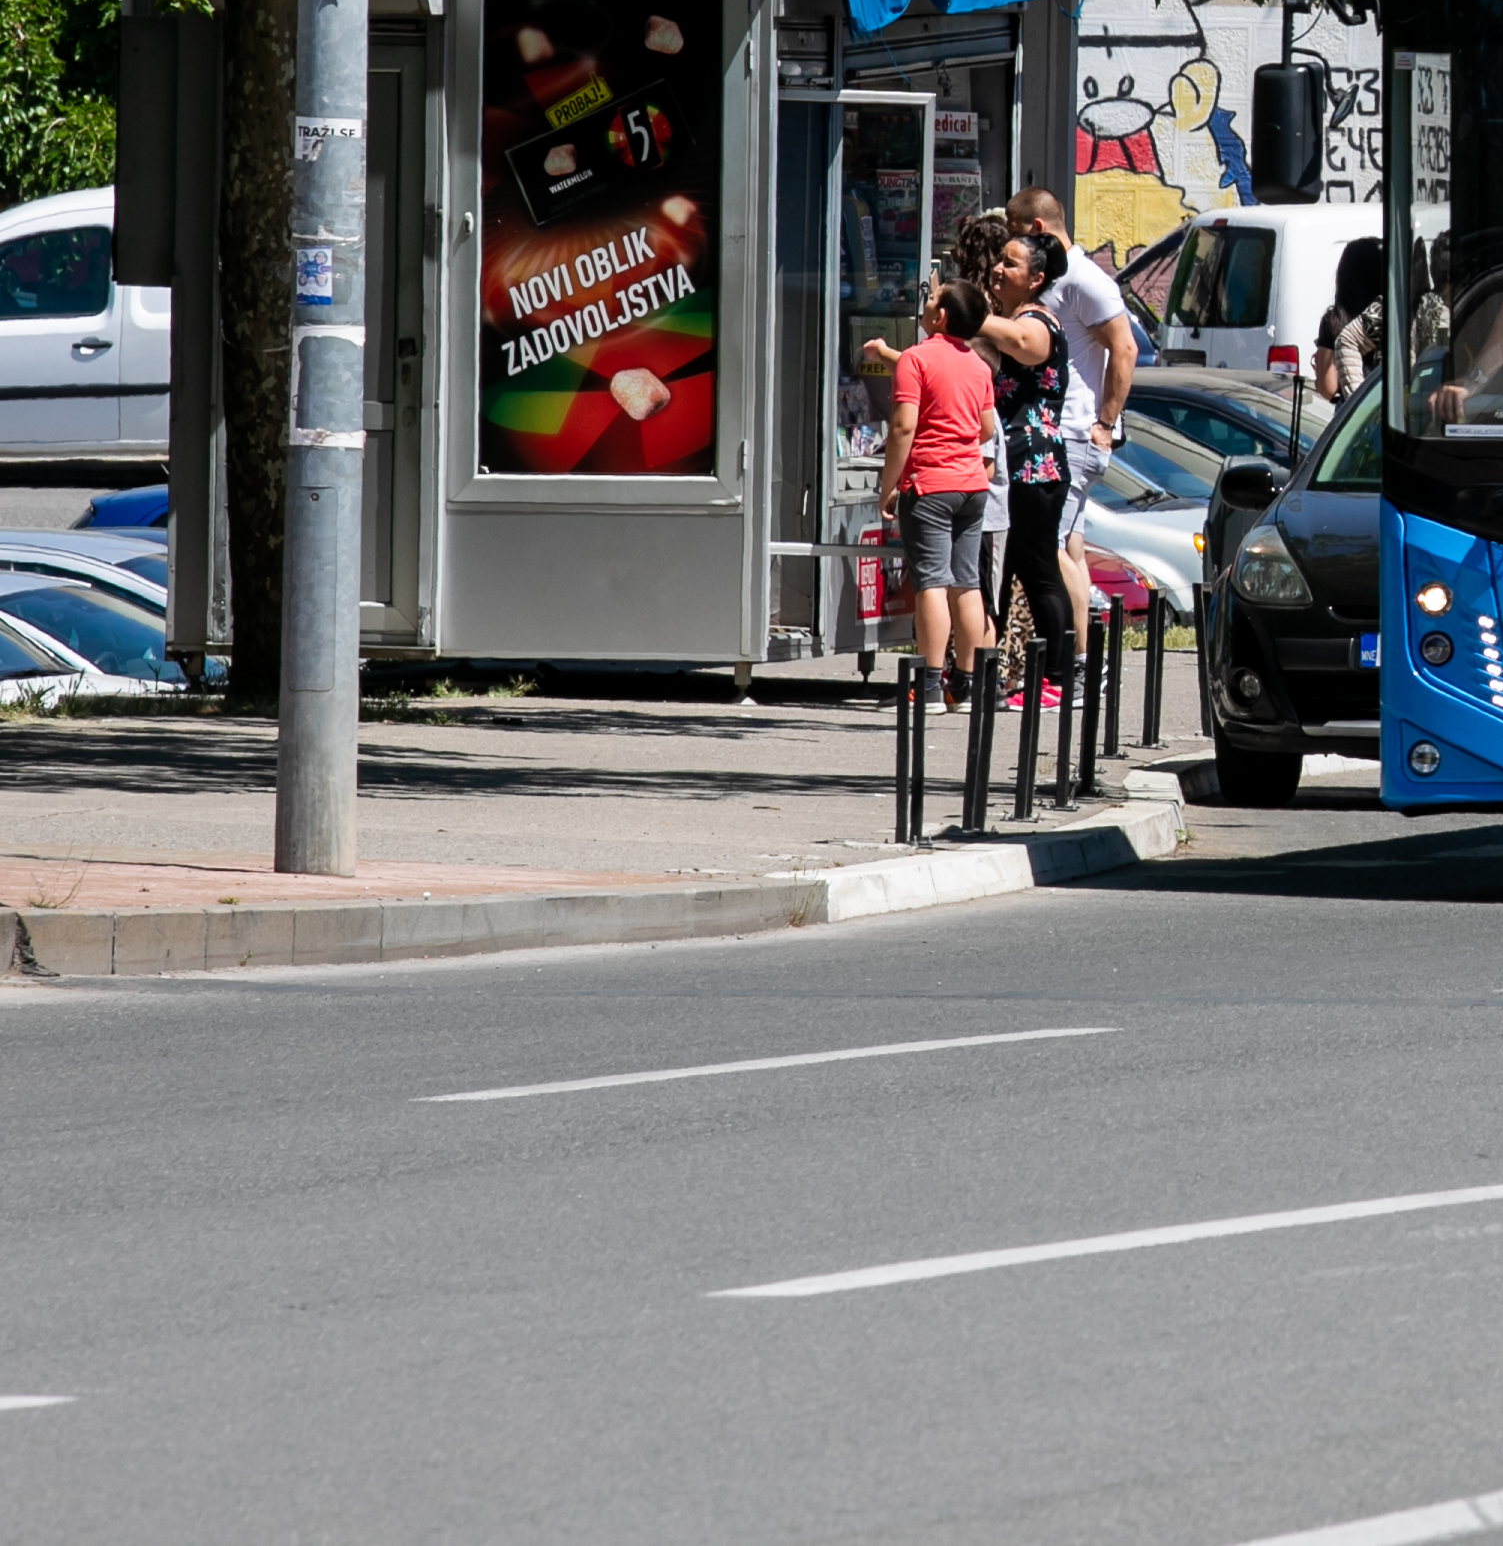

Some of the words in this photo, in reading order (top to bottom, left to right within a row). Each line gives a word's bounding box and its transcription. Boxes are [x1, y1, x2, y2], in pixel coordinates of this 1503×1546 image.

[554, 75, 606, 126] PROBAJ!
[627, 110, 649, 162] 5
[549, 169, 594, 194] WATERMELON
[509, 263, 574, 319] NOVI
[574, 226, 656, 288] OBLIK
[501, 264, 696, 377] ZADOVOLJSTVA
